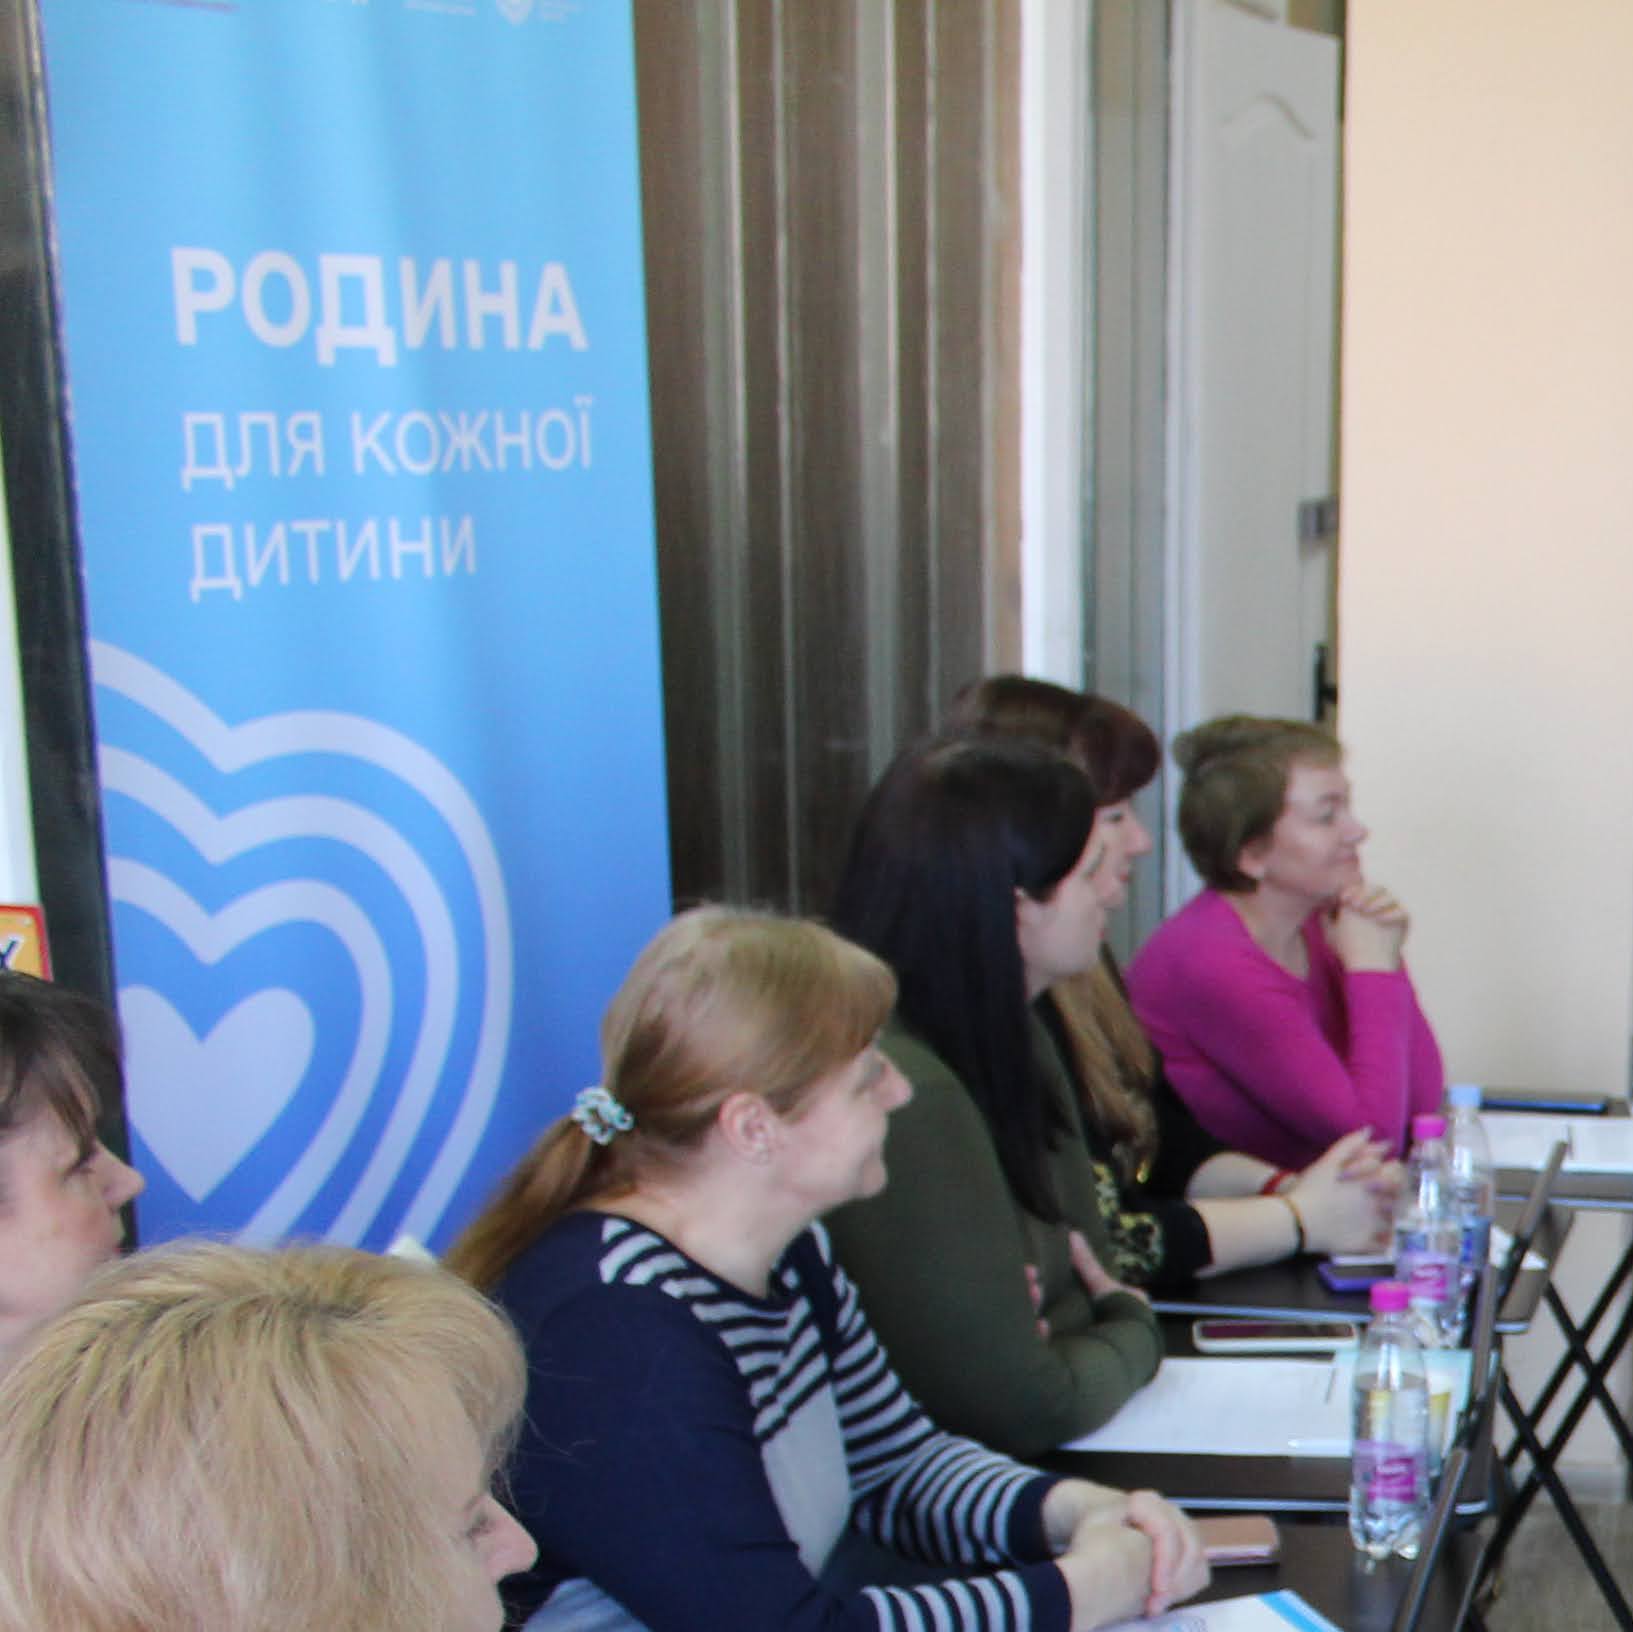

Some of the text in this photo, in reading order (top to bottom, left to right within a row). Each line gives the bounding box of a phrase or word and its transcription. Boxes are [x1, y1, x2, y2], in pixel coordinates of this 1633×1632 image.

[170, 247, 589, 367] РОДИНА
[180, 394, 596, 492] ДЛЯ КОЖНОЇ
[188, 514, 477, 604] ДИТИНИ
